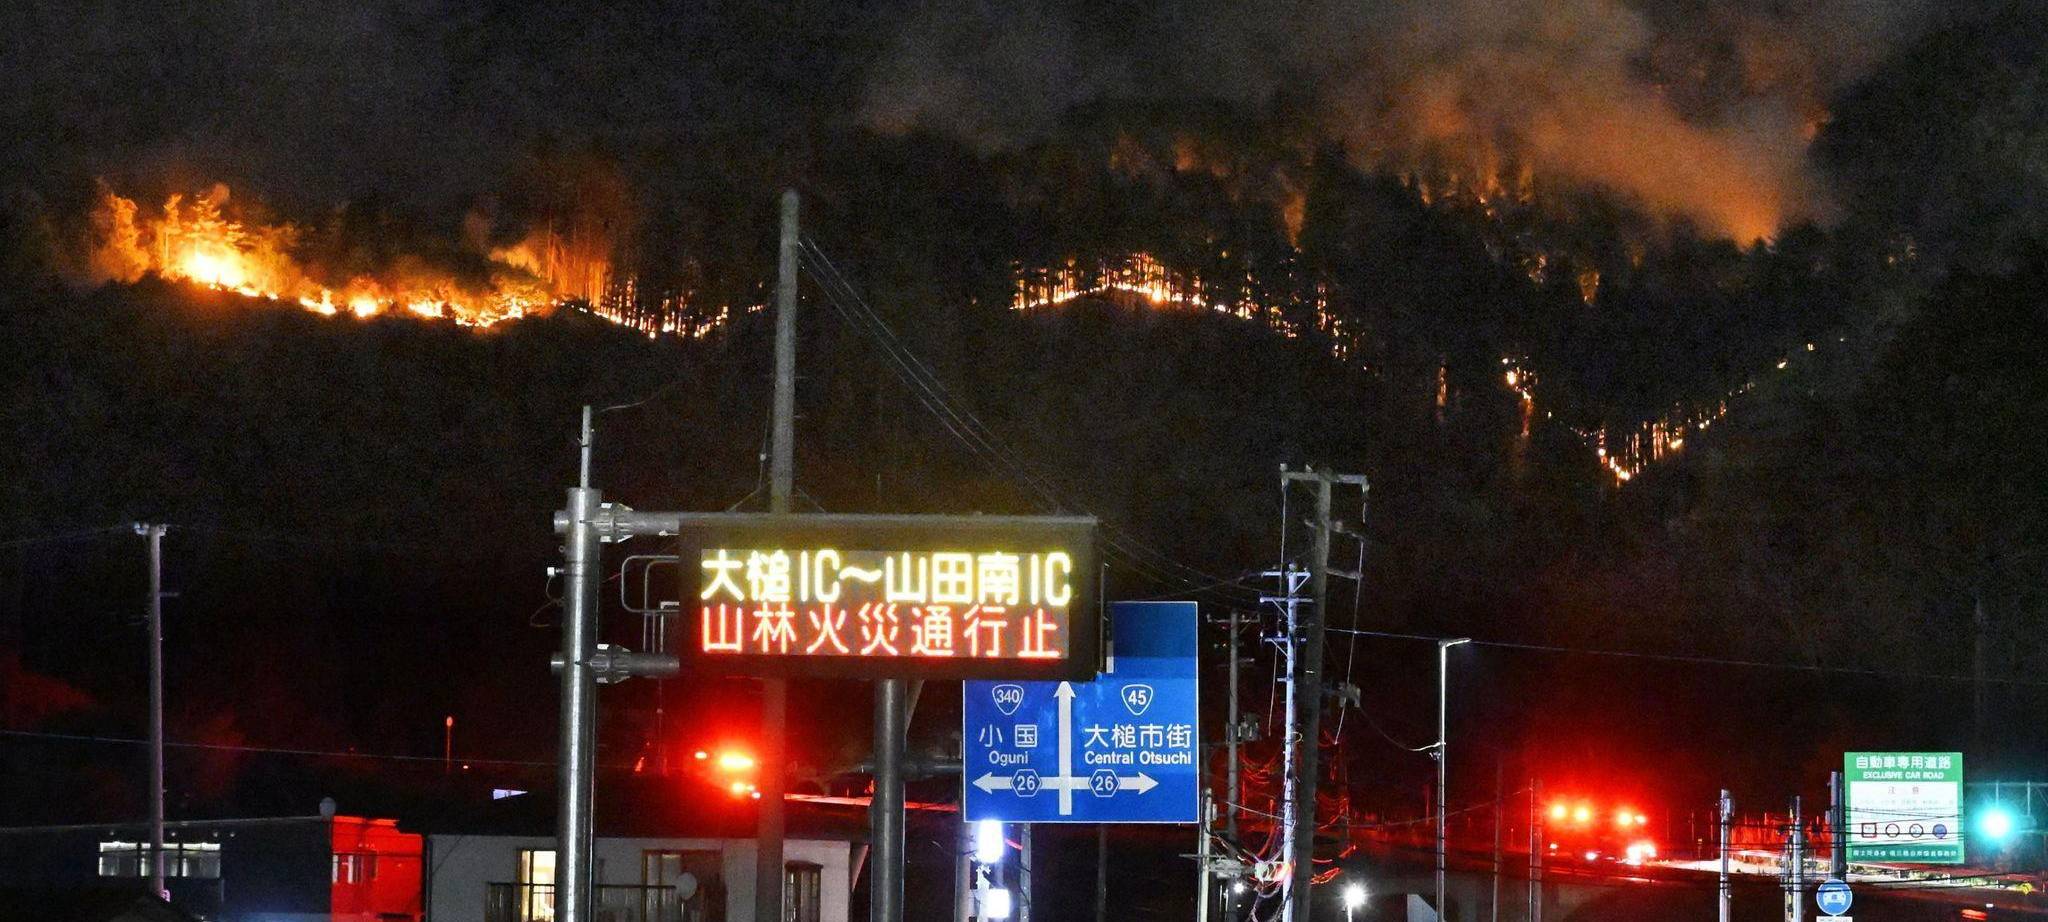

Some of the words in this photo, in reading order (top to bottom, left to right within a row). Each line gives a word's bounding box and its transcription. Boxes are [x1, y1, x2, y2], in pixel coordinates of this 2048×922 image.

[701, 603, 1061, 658] 山林火災通行止
[996, 690, 1020, 704] 340
[1128, 690, 1147, 705] 45
[979, 724, 1038, 748] 小国
[1084, 723, 1192, 749] 大槌市街
[988, 751, 1029, 767] Oguni
[1084, 751, 1134, 765] Central
[1139, 751, 1192, 765] Otsuchi
[1856, 755, 1951, 769] 自動車専用道路
[1863, 771, 1903, 779] EXCLUSIVE
[1905, 771, 1921, 779] CAR
[1923, 771, 1945, 779] ROAD
[1016, 777, 1036, 791] 26
[1095, 777, 1114, 791] 26
